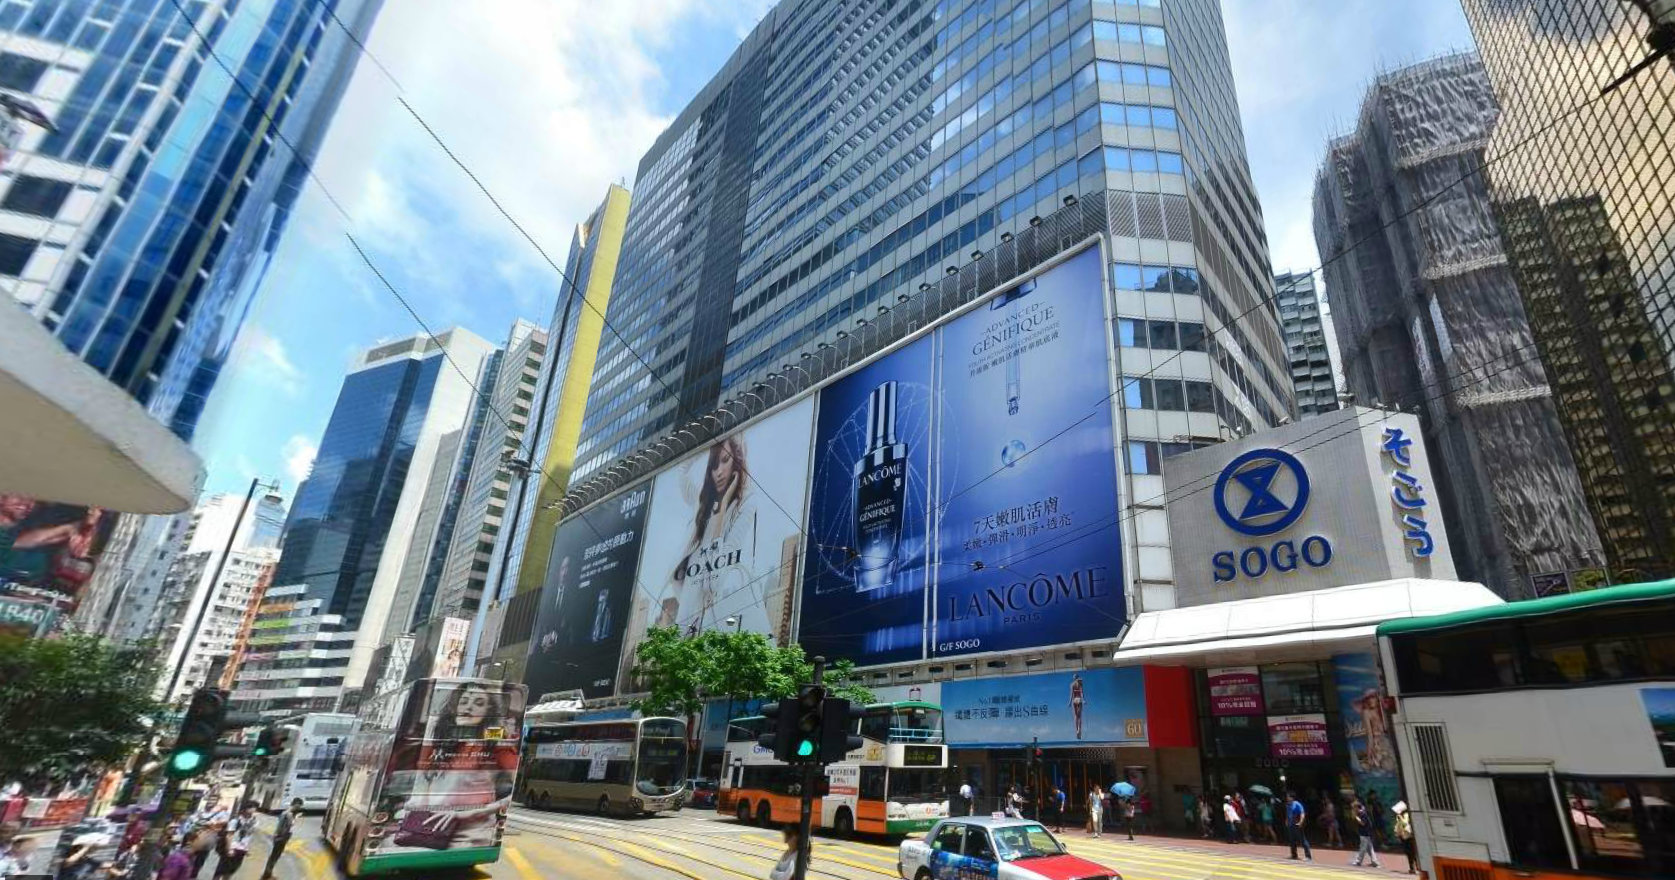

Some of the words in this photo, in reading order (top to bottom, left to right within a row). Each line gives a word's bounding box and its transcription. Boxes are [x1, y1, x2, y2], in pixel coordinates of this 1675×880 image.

[858, 463, 902, 489] LANCÔME
[1382, 427, 1434, 558] そごう
[973, 496, 1059, 535] 7天嫩肌活膚
[1212, 535, 1333, 583] SOGO
[949, 566, 1109, 622] LANCÔME
[1003, 613, 1041, 625] PARIS
[939, 641, 954, 652] G/F
[955, 638, 981, 651] SOGO
